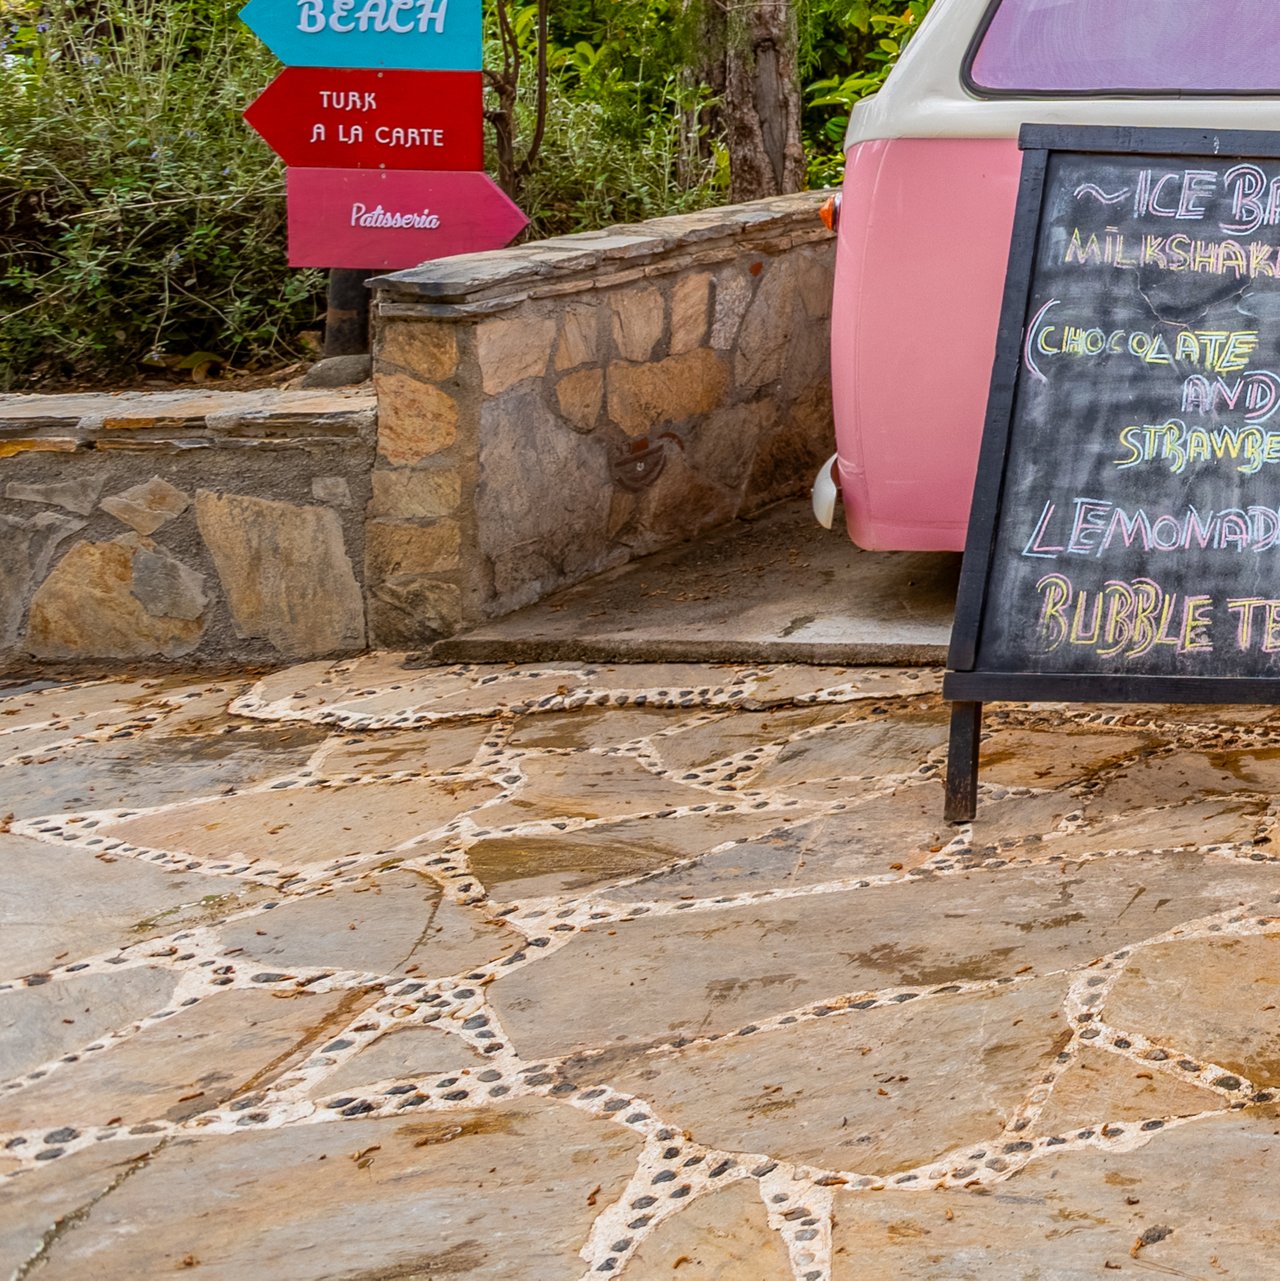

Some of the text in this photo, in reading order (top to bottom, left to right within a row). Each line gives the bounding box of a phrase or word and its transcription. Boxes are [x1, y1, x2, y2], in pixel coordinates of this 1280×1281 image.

[320, 91, 377, 111] TURK
[310, 123, 444, 147] A LA CARTE
[1134, 169, 1217, 220] ICE
[351, 202, 440, 231] Patisseria
[1035, 572, 1214, 659] BUBBLE
